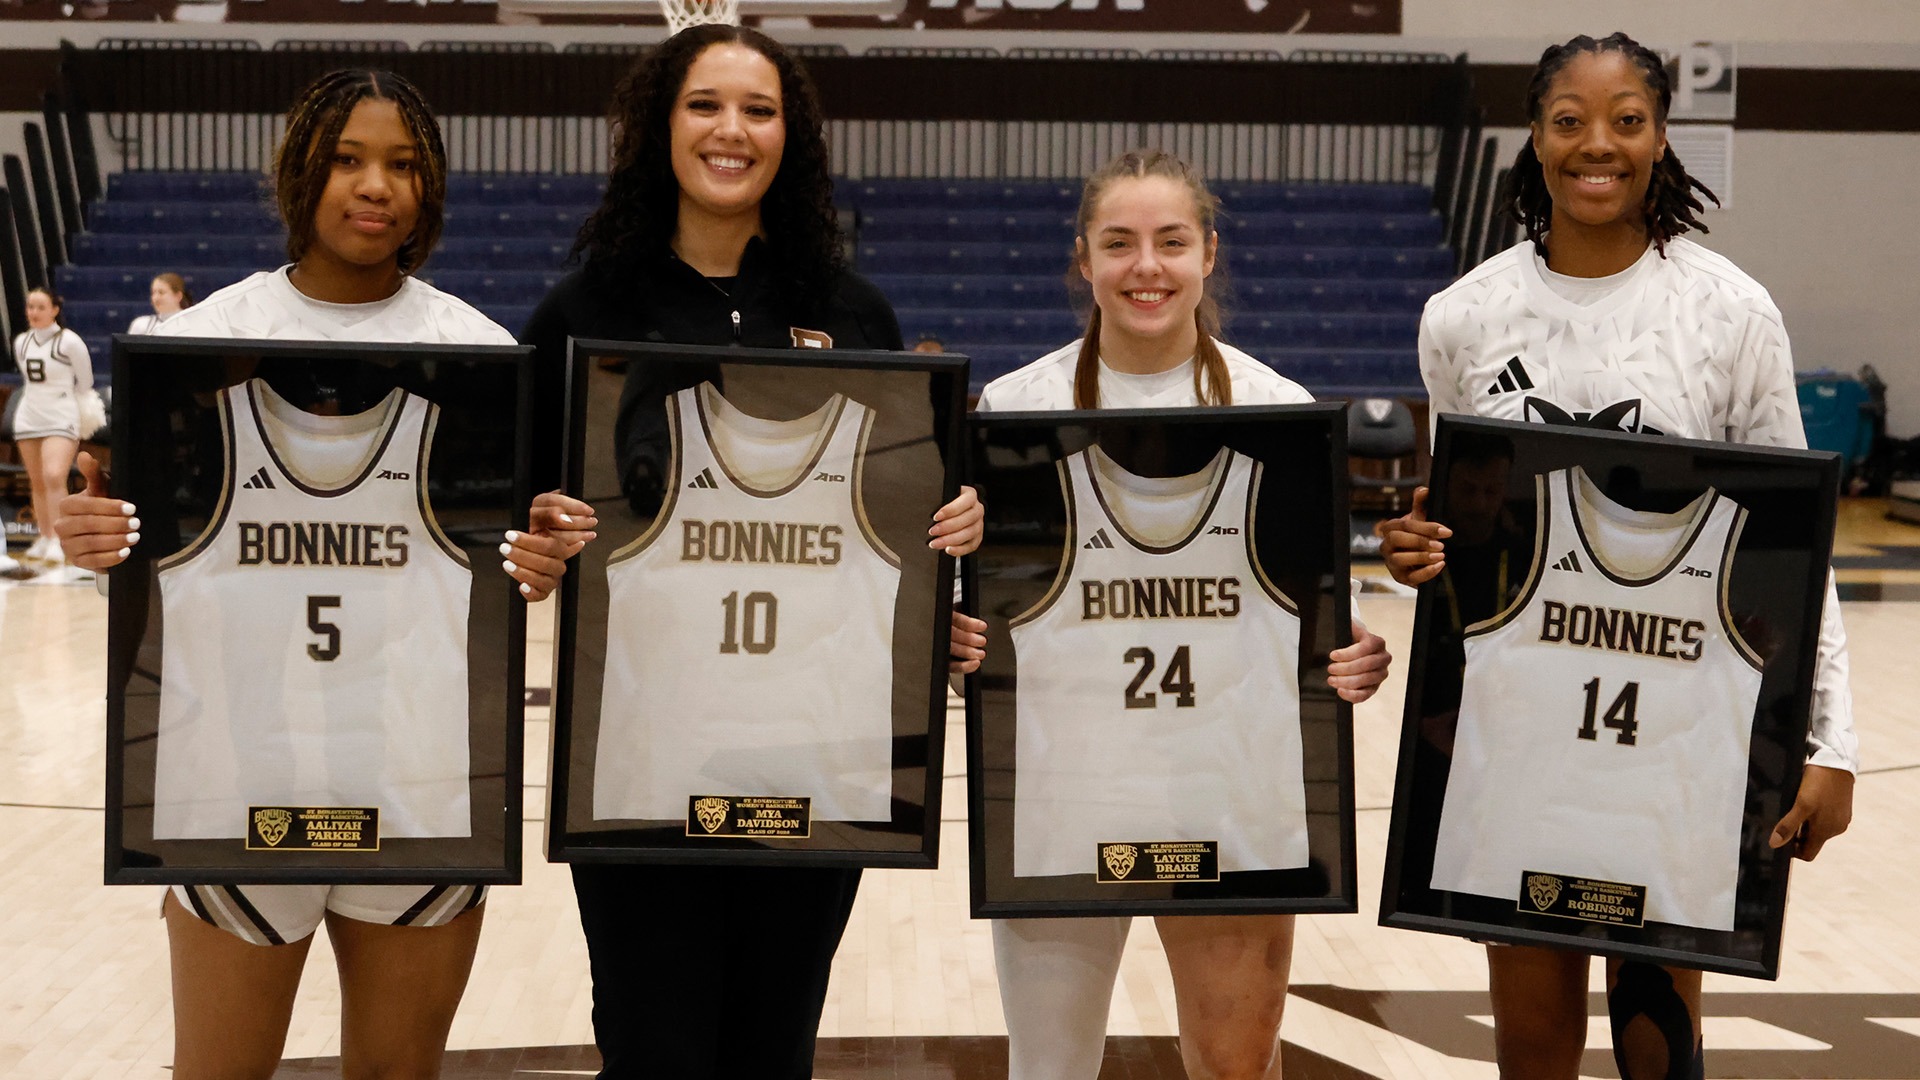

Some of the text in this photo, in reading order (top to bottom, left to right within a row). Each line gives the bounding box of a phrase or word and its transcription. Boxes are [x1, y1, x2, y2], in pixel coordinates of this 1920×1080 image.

[26, 359, 45, 382] B
[238, 521, 410, 568] BONNIES
[681, 519, 844, 566] BONNIES
[1080, 577, 1241, 621] BONNIES
[306, 595, 341, 662] 5
[719, 590, 778, 655] 10
[1538, 599, 1707, 662] BONNIES
[1122, 644, 1197, 709] 24
[1577, 676, 1640, 746] 14
[694, 797, 730, 811] BONNIES
[254, 809, 292, 823] BONNIES
[756, 809, 782, 818] MYA
[306, 821, 362, 830] AALIYAH
[737, 819, 799, 828] DAVIDSON
[307, 831, 361, 840] PARKER
[1103, 844, 1138, 858] BONNIES
[1153, 854, 1201, 863] LAYCEE
[1155, 863, 1199, 873] DRAKE
[1527, 875, 1563, 891] BONNIES
[1587, 881, 1632, 891] BONAVENTURE
[1581, 891, 1624, 905] GABBY
[1599, 887, 1639, 897] BASKETBALL
[1567, 900, 1636, 917] ROBINSON
